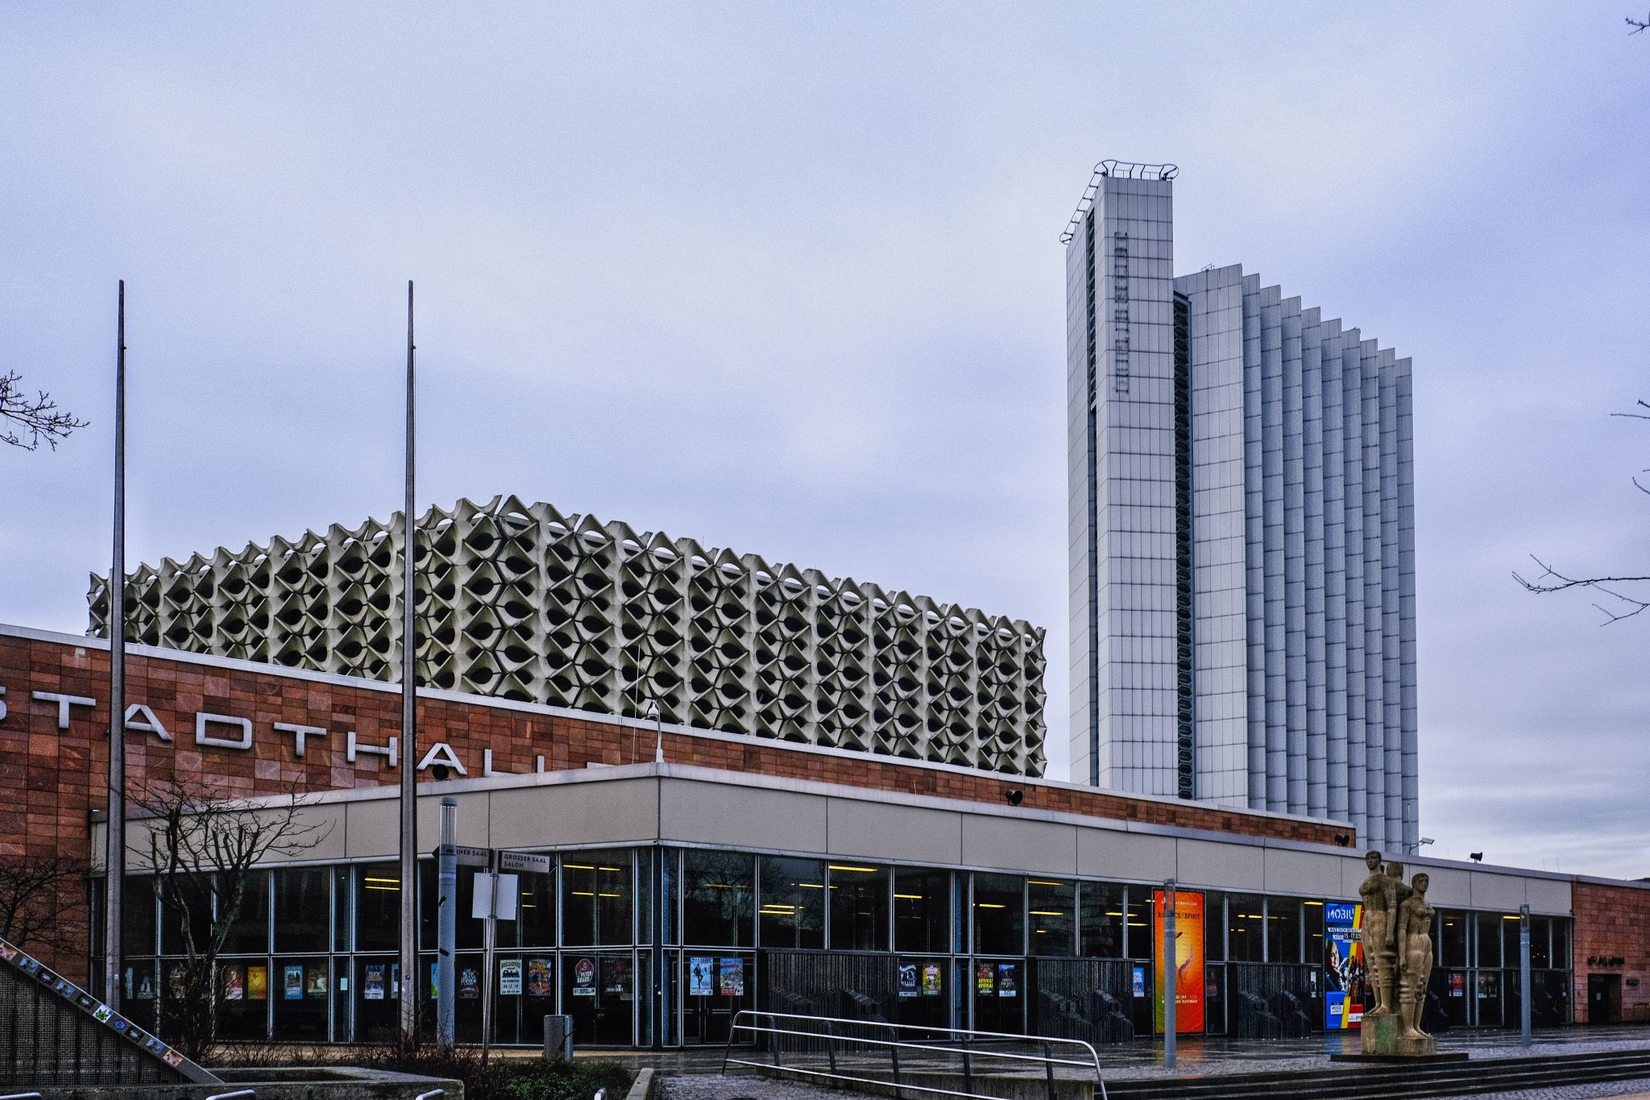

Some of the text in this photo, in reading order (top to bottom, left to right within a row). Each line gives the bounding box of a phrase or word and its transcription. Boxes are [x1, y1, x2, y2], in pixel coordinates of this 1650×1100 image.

[472, 849, 487, 857] SAAL
[504, 853, 547, 864] GROSSER SAAL
[504, 861, 524, 869] SALON
